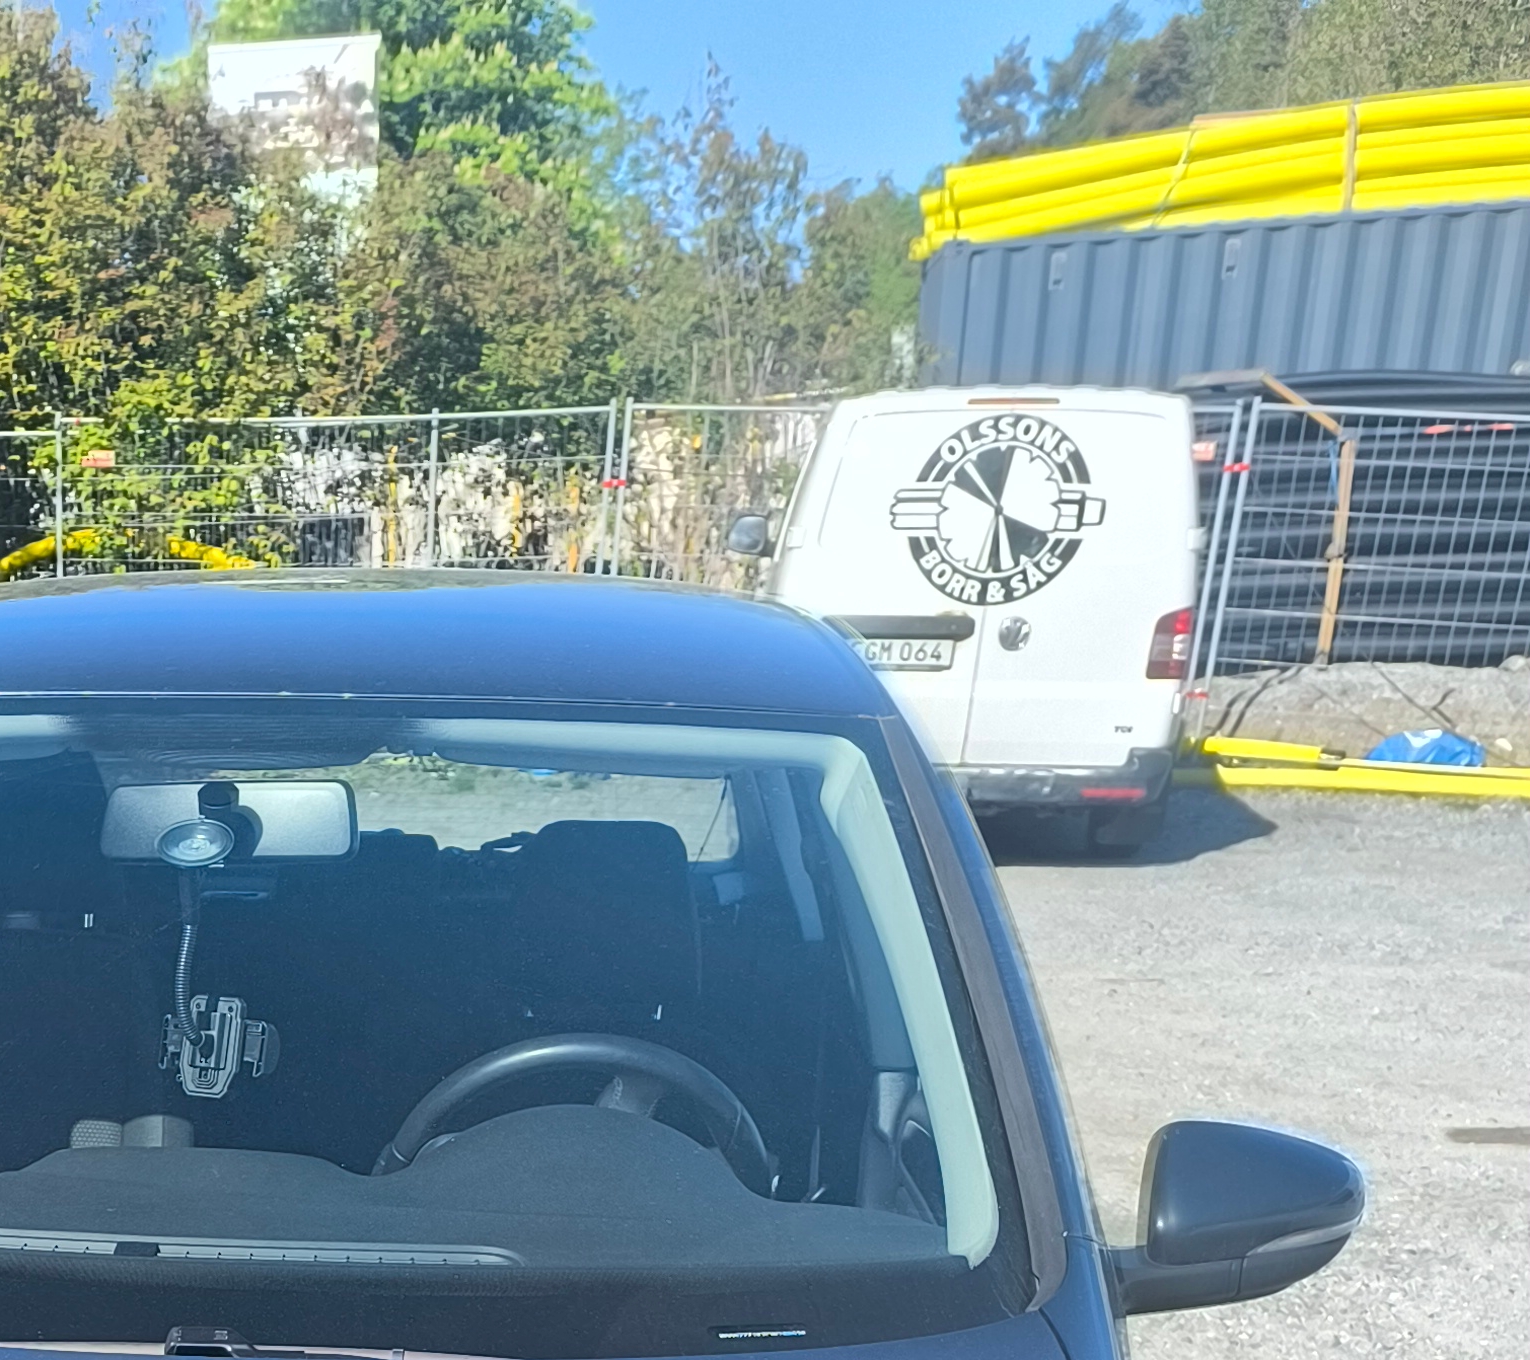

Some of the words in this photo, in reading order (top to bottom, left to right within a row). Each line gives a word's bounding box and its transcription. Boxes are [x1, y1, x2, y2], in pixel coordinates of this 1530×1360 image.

[940, 416, 1076, 464] OLSSONS
[919, 549, 982, 603] BORR
[985, 580, 1006, 603] &
[1009, 552, 1063, 598] SÅG
[899, 641, 942, 662] 064
